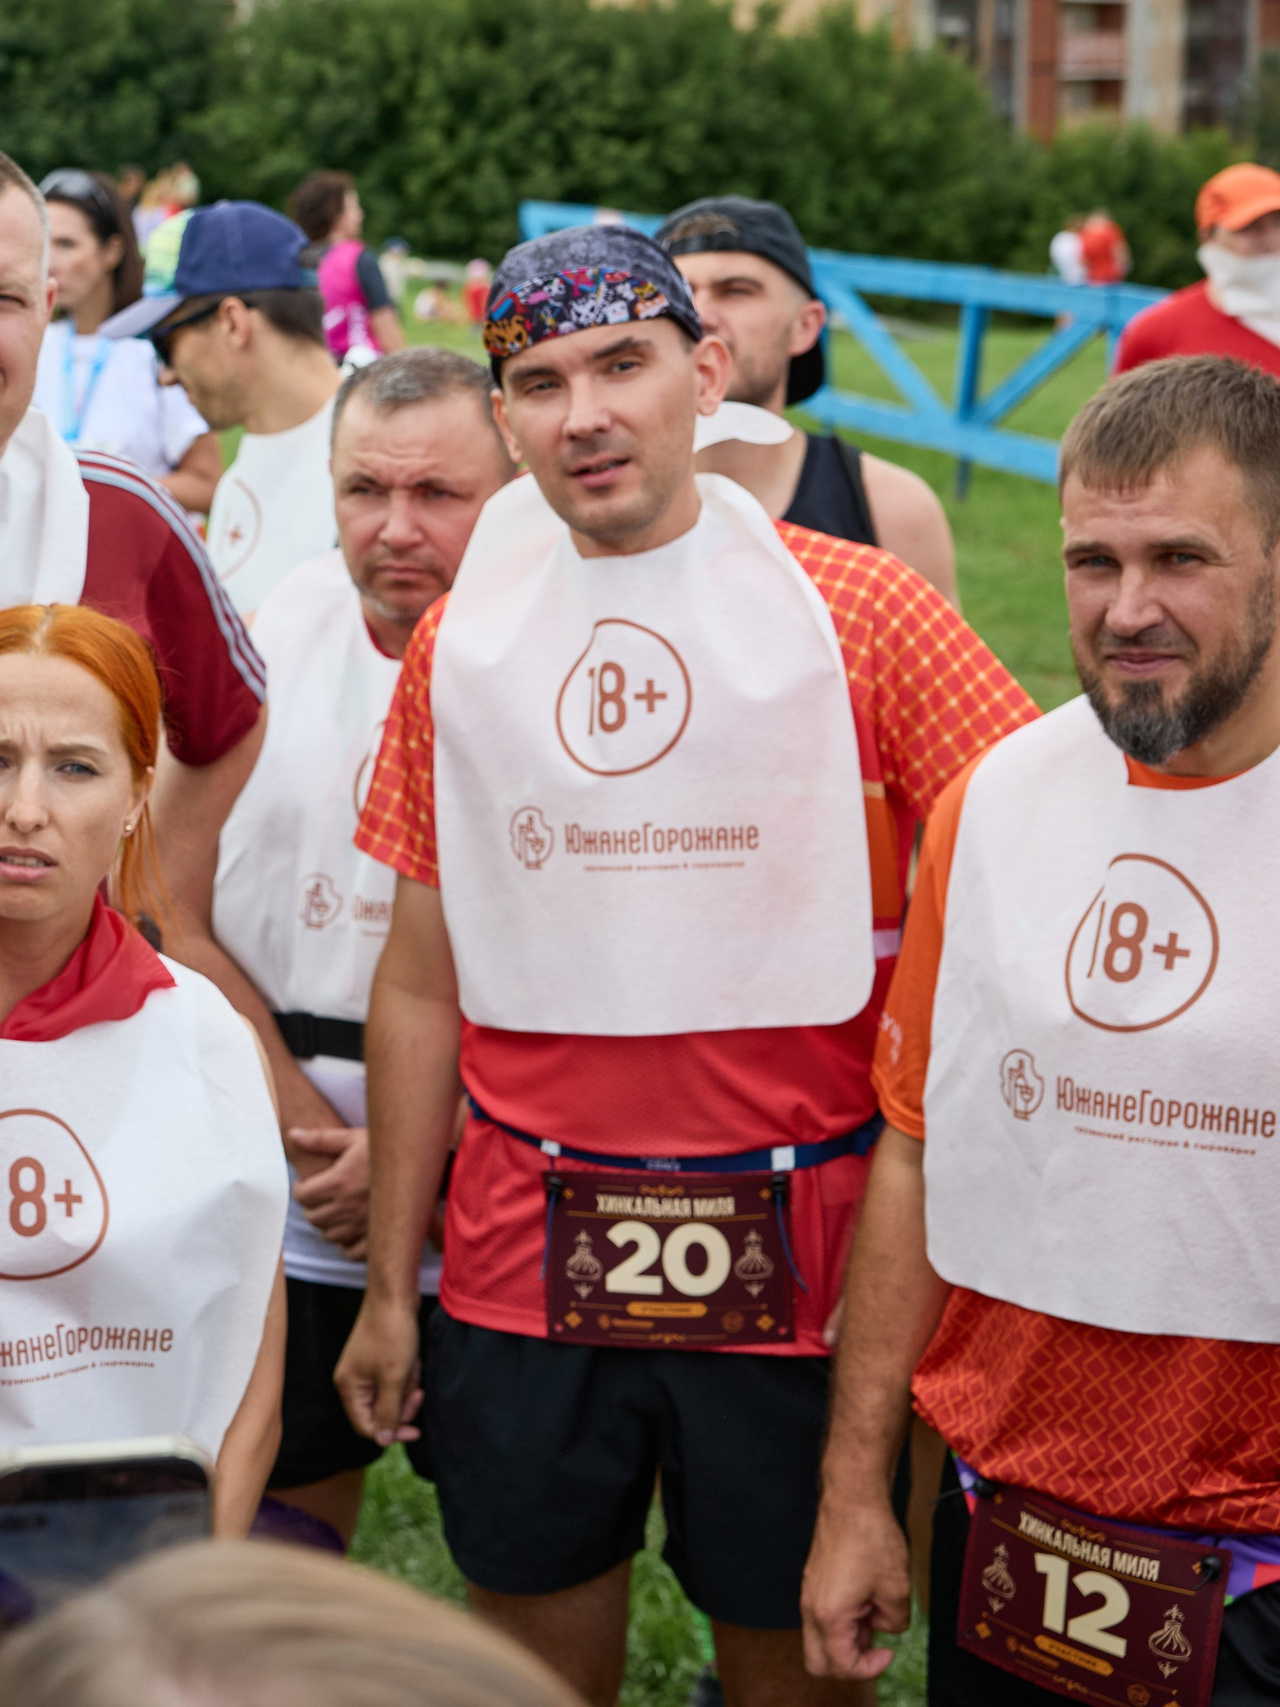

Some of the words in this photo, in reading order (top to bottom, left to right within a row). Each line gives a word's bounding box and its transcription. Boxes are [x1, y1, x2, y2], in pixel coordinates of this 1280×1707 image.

[587, 661, 668, 736] 18+
[1086, 901, 1191, 983] 18+
[692, 1196, 735, 1218] МИЛЯ
[605, 1219, 732, 1297] 20
[1018, 1510, 1111, 1567] ХИНКАЛЬНАЯ
[1112, 1550, 1160, 1583] МИЛЯ
[1034, 1552, 1130, 1658] 12
